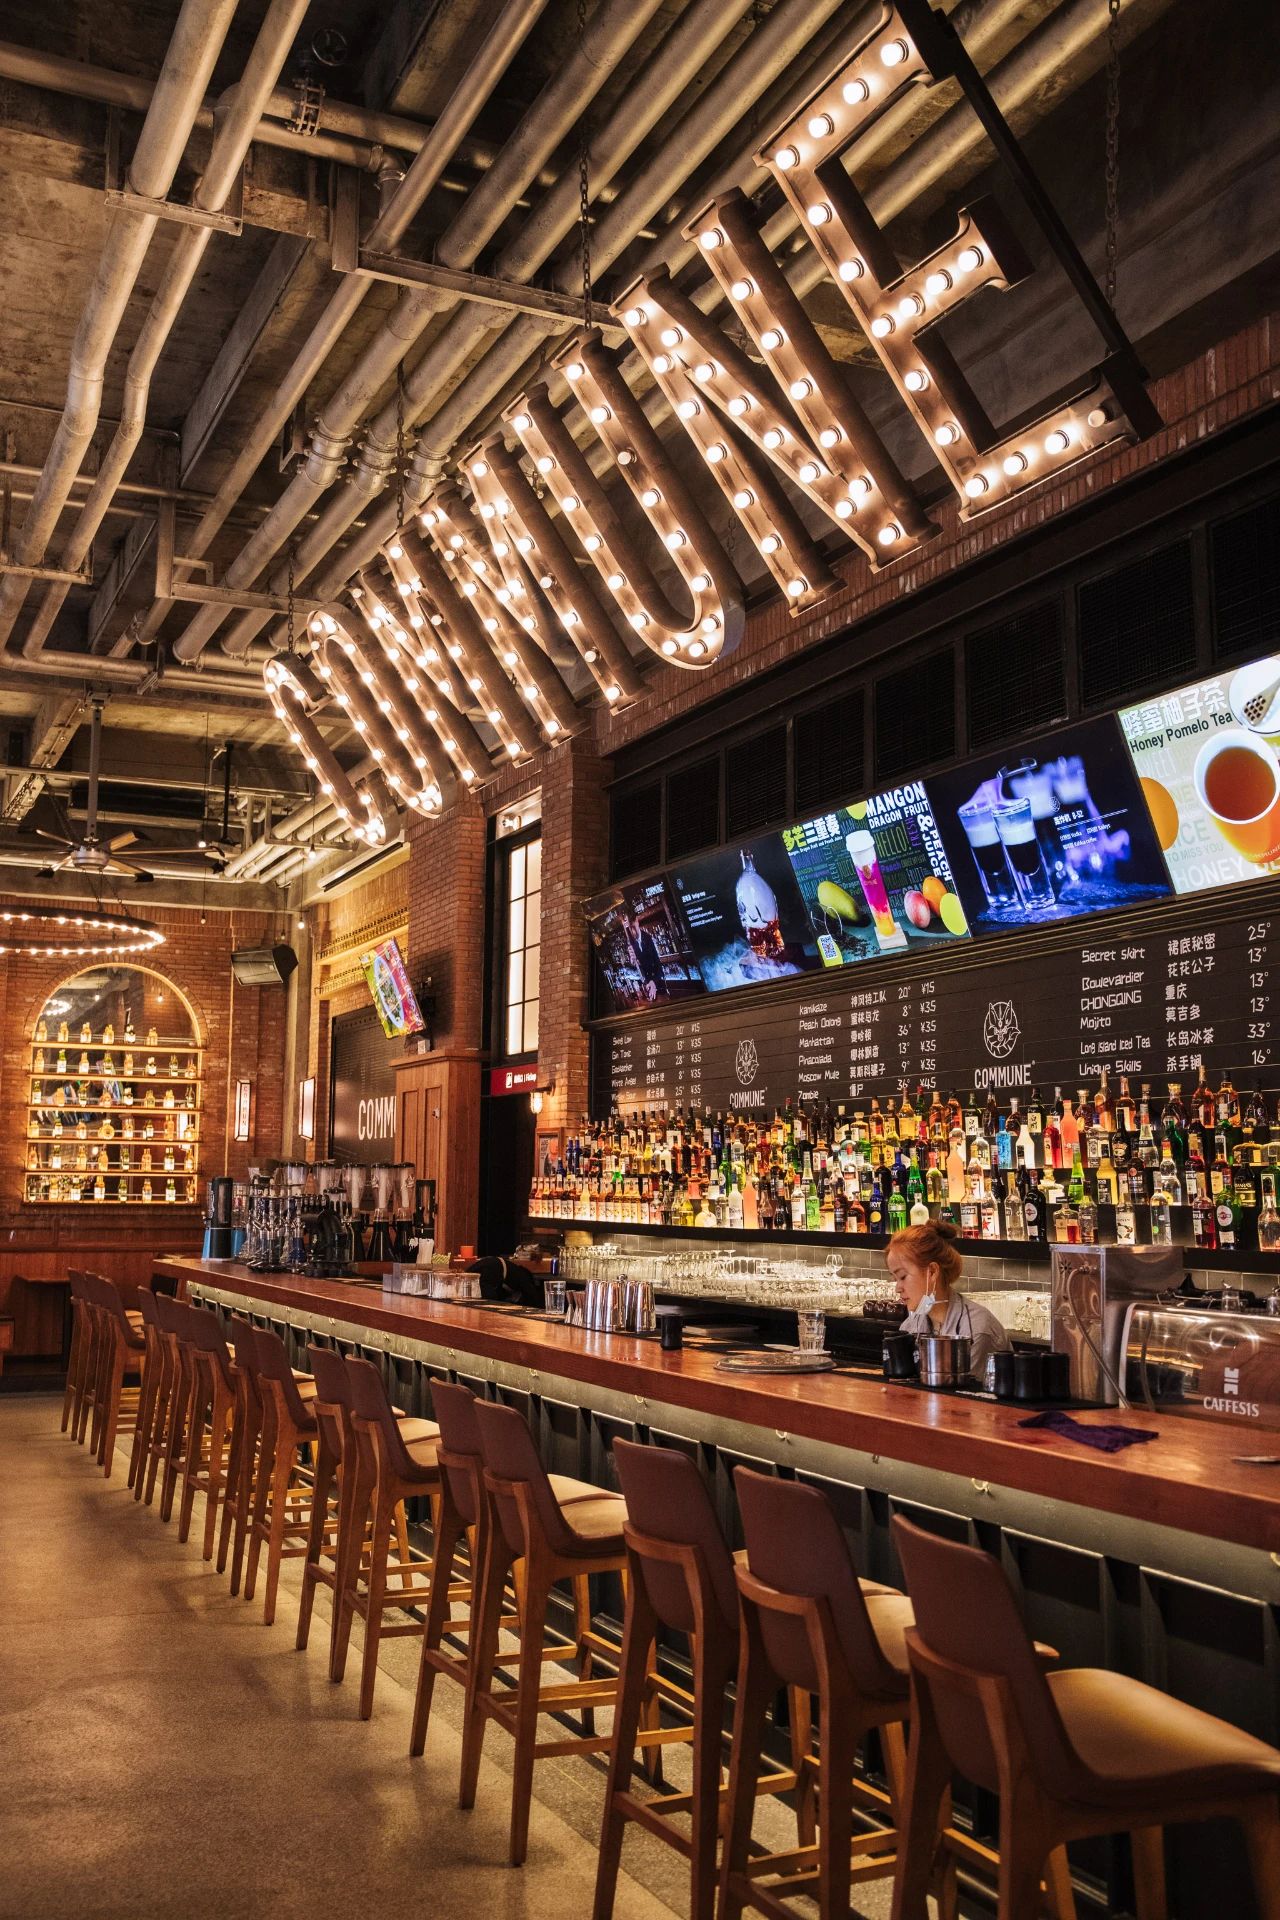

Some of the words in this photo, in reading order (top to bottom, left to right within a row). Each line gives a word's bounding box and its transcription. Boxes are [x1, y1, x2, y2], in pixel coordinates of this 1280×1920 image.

[262, 2, 1140, 846] COMMUNE
[1121, 681, 1228, 740] 蜂蜜柚子茶
[1130, 734, 1164, 753] Honey
[1166, 719, 1210, 742] Pomelo
[1210, 712, 1233, 728] Tea
[866, 780, 927, 818] MANGON
[868, 809, 901, 830] DRAGON
[904, 800, 930, 818] FRUIT
[917, 814, 934, 832] &
[874, 822, 912, 858] HELLO!
[904, 817, 922, 846] FRESH
[922, 833, 942, 876] JUICE
[930, 830, 952, 882] PEACH
[1172, 856, 1244, 890] HONEY
[1082, 950, 1116, 963] Secret
[1168, 933, 1216, 956] 裙底秘密
[1082, 972, 1144, 990] Boulevardier
[1168, 957, 1215, 978] 花花公子
[851, 990, 886, 1008] 神风特工队
[921, 981, 935, 994] ¥15
[1080, 990, 1142, 1011] CHONGQING
[1166, 983, 1187, 1000] 重庆
[799, 1019, 818, 1031] Peach
[850, 1010, 880, 1026] 蜜桃乌龙
[920, 1000, 936, 1014] ¥35
[1080, 1016, 1111, 1030] Mojito
[1166, 1004, 1200, 1022] 莫吉多
[691, 1038, 701, 1048] ¥35
[799, 1037, 834, 1048] Manhattan
[850, 1028, 872, 1043] 曼哈顿
[920, 1020, 937, 1033] ¥35
[1080, 1042, 1095, 1054] Long
[1136, 1036, 1150, 1048] Tea
[1166, 1027, 1214, 1047] 长岛冰茶
[691, 1052, 701, 1062] ¥35
[798, 1054, 832, 1066] Pinacolada
[920, 1040, 937, 1052] ¥35
[1080, 1063, 1111, 1076] Unique
[1116, 1060, 1142, 1073] Skills
[1166, 1054, 1202, 1072] 杀手锏
[646, 1072, 664, 1084] 白色天使
[691, 1068, 701, 1078] ¥35
[798, 1072, 822, 1083] Moscow
[824, 1070, 840, 1080] Mule
[850, 1063, 886, 1079] 莫斯科骡子
[920, 1058, 936, 1071] ¥35
[974, 1064, 1032, 1088] COMMUNE
[691, 1084, 701, 1094] ¥35
[730, 1090, 765, 1108] COMMUNE
[798, 1090, 819, 1100] Zombie
[849, 1084, 864, 1097] 僵尸
[920, 1076, 937, 1090] ¥45
[1204, 1396, 1260, 1418] CAFFESIS
